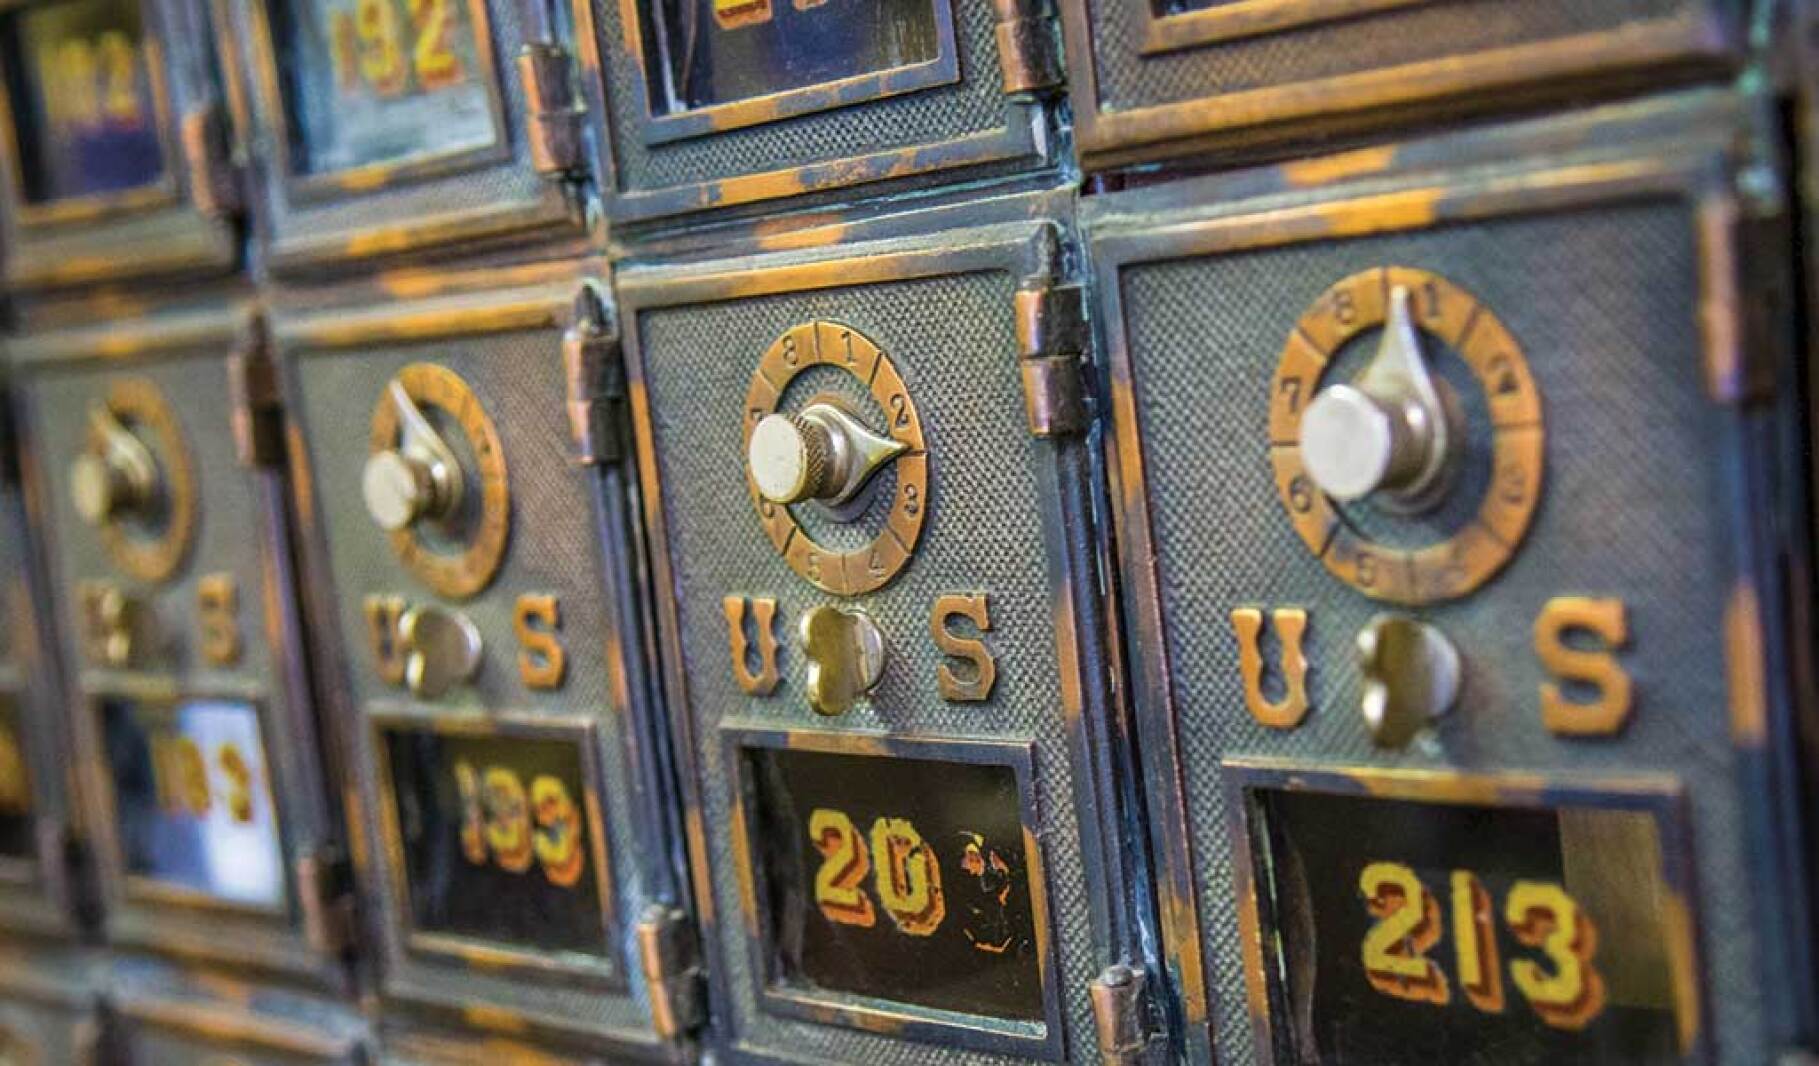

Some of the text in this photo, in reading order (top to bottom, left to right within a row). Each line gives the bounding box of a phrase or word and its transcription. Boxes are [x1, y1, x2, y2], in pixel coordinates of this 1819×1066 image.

[332, 0, 466, 98] 192
[1334, 290, 1356, 326] 8
[1424, 279, 1440, 319] 1
[782, 335, 798, 369] 8
[840, 330, 858, 367] 1
[889, 392, 909, 432] 2
[1280, 375, 1304, 415] 7
[903, 483, 919, 516] 3
[1288, 475, 1312, 514] 6
[513, 595, 566, 690] S
[724, 594, 997, 702] U S
[1230, 596, 1635, 737] U S
[808, 808, 1013, 953] 20
[1358, 861, 1607, 1031] 213
